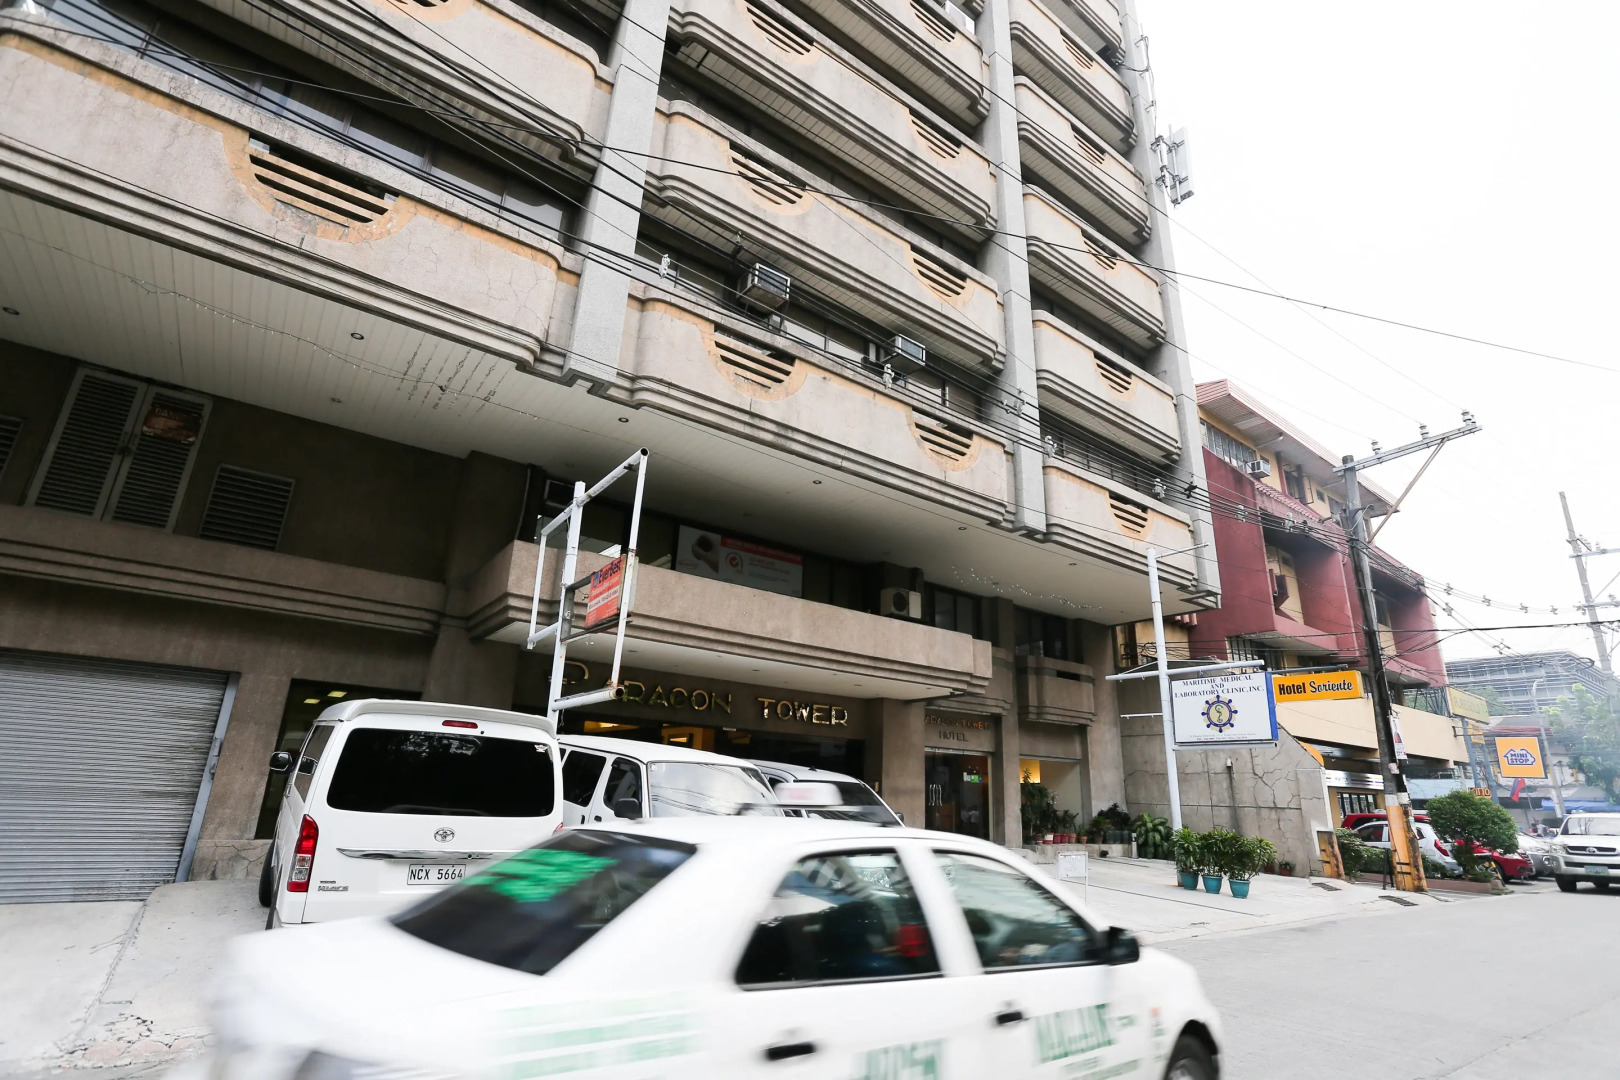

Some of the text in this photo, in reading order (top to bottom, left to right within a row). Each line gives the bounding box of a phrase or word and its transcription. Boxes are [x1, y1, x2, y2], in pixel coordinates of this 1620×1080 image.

[1182, 674, 1254, 686] MARITIME MEDICAL
[548, 660, 848, 726] PRAGON TOWER
[1278, 679, 1353, 695] Hotel Soriente
[1174, 689, 1221, 698] LABORATORY
[938, 730, 969, 742] HOTEL
[409, 868, 463, 880] NCX 5664
